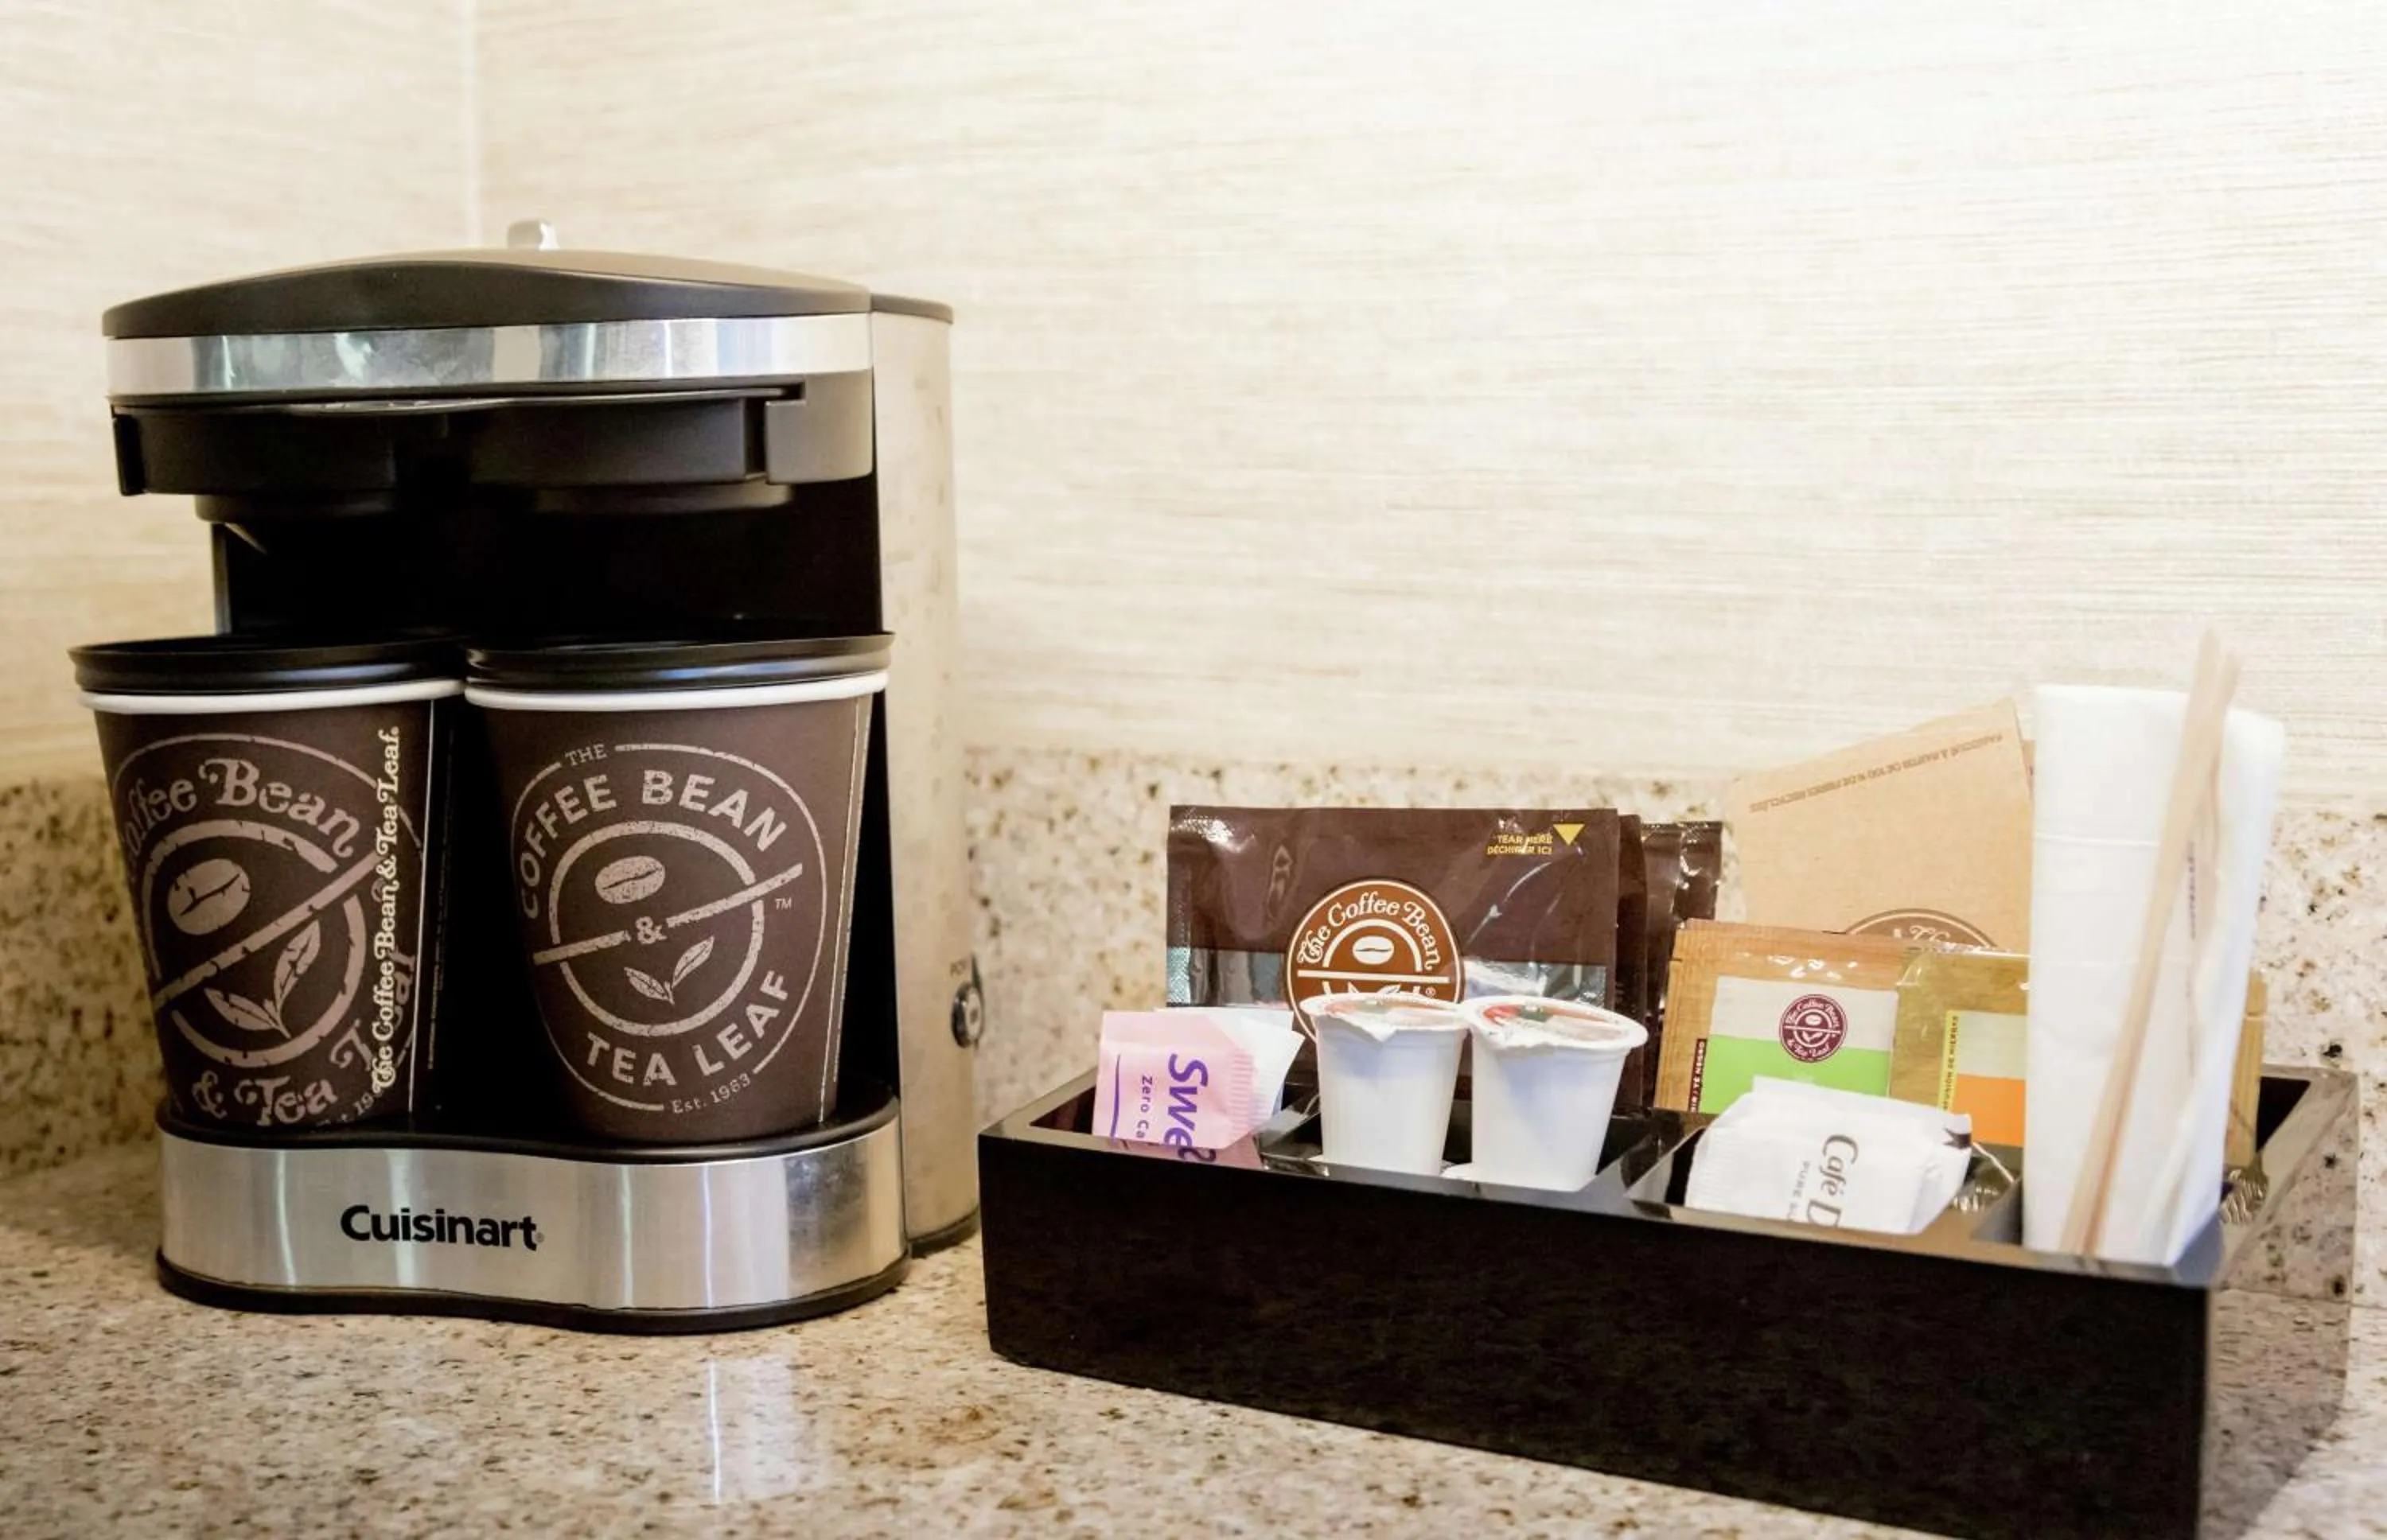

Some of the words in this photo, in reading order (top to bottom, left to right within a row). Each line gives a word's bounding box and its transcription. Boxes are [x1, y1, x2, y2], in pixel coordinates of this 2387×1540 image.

[564, 743, 608, 767] THE
[199, 759, 360, 858] Bean
[375, 804, 398, 856] Tea
[520, 773, 617, 920] COFFEE
[641, 768, 787, 853] BEAN
[1497, 834, 1524, 845] TEAR
[376, 854, 397, 880] &
[374, 879, 399, 959] Bean
[774, 898, 792, 910] TM
[635, 916, 667, 945] &
[1296, 925, 1332, 965] The
[1326, 891, 1402, 928] Coffee
[1402, 900, 1443, 972] Bean
[372, 960, 395, 1041] Coffee
[584, 1032, 677, 1087] TEA
[692, 969, 789, 1077] LEAF
[372, 1044, 396, 1095] The
[671, 1098, 707, 1114] Est.
[711, 1072, 752, 1104] 1963
[1139, 1075, 1154, 1114] Zero
[192, 1071, 228, 1118] &
[235, 1075, 338, 1126] Tea
[1819, 1134, 1859, 1196] Café
[340, 1204, 538, 1251] Cuisinart
